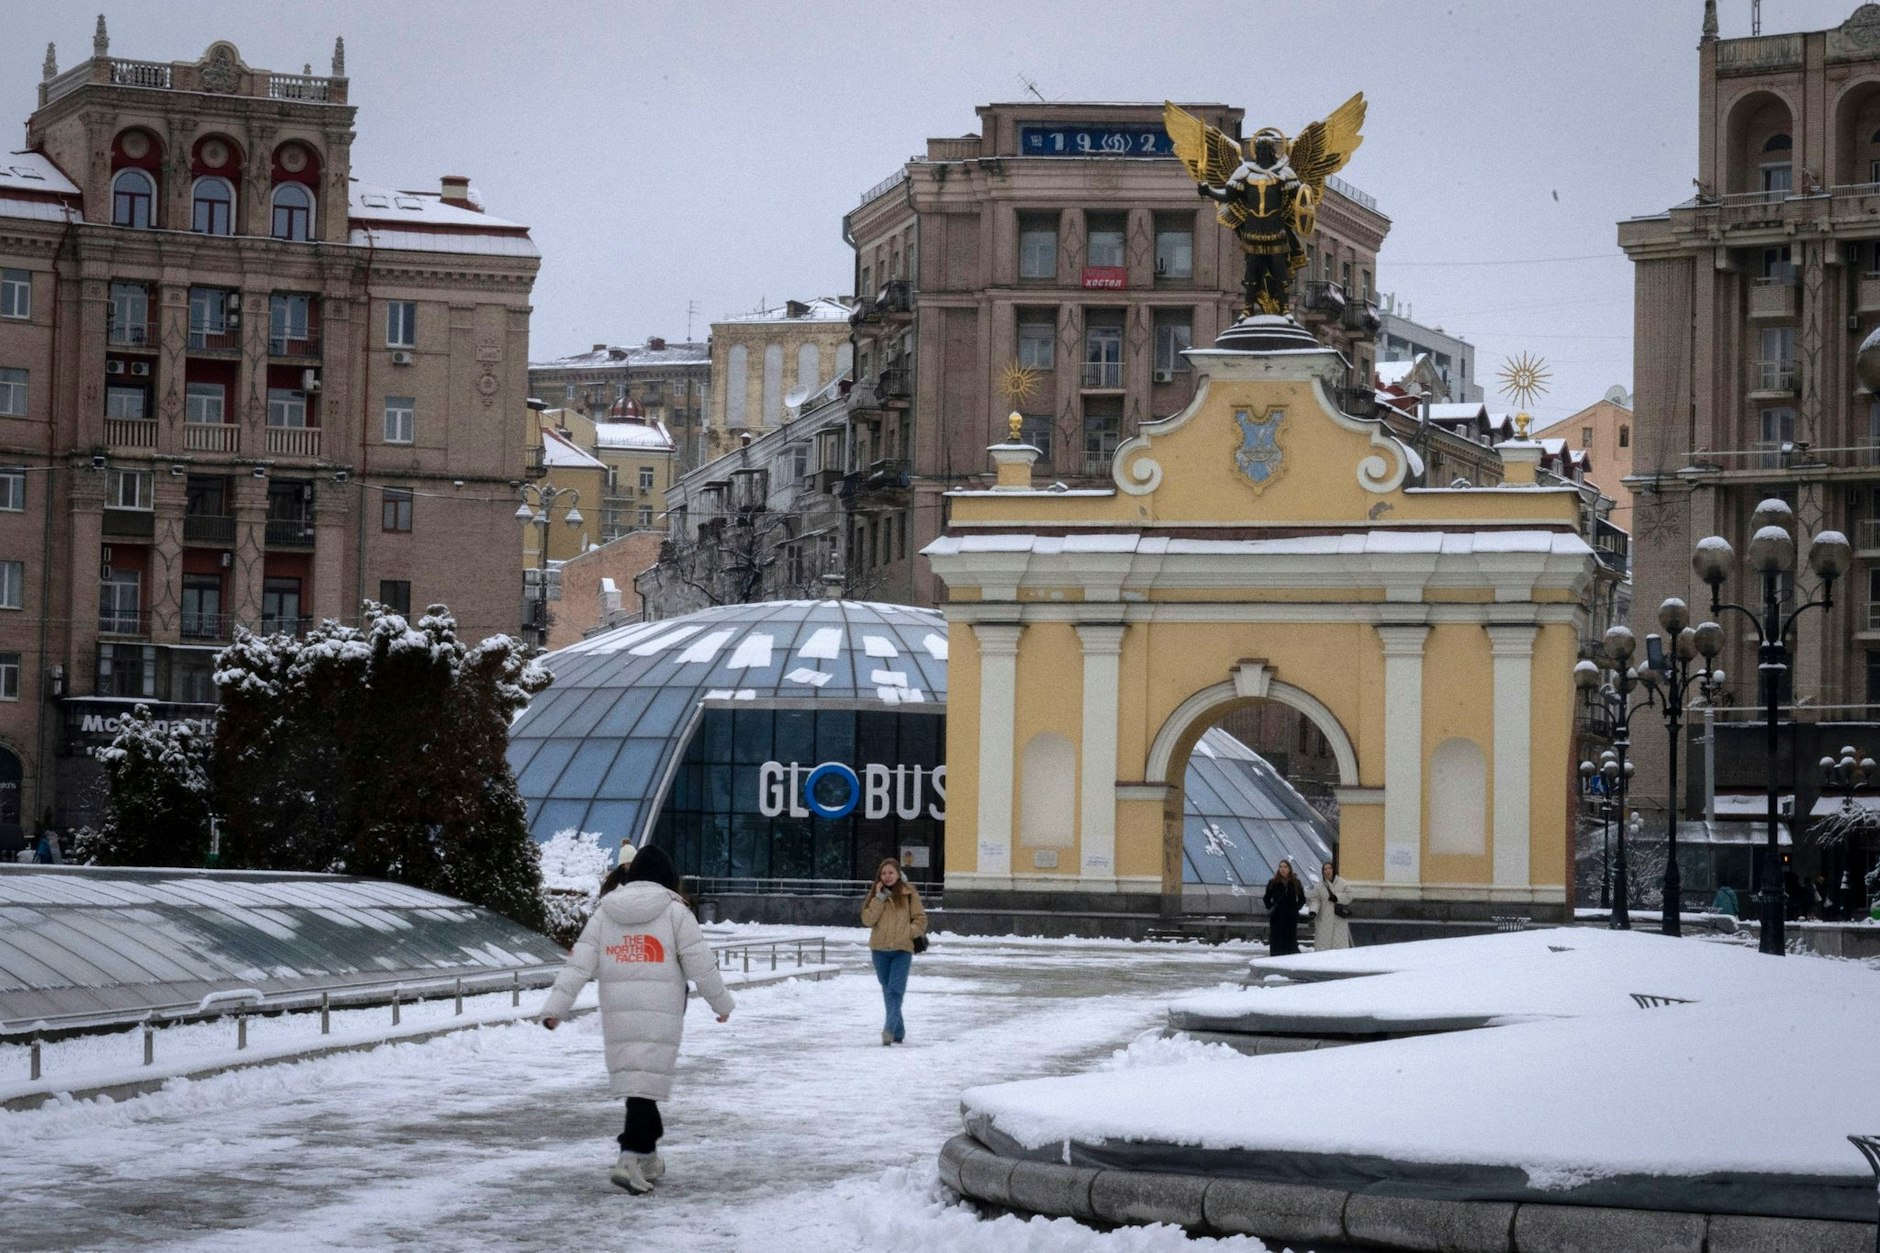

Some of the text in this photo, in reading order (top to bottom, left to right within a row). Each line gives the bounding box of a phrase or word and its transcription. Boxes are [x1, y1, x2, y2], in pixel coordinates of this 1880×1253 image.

[759, 761, 946, 821] GLOBUS
[622, 935, 643, 945] THE
[606, 944, 643, 955] NORTH
[616, 954, 643, 963] FACE
